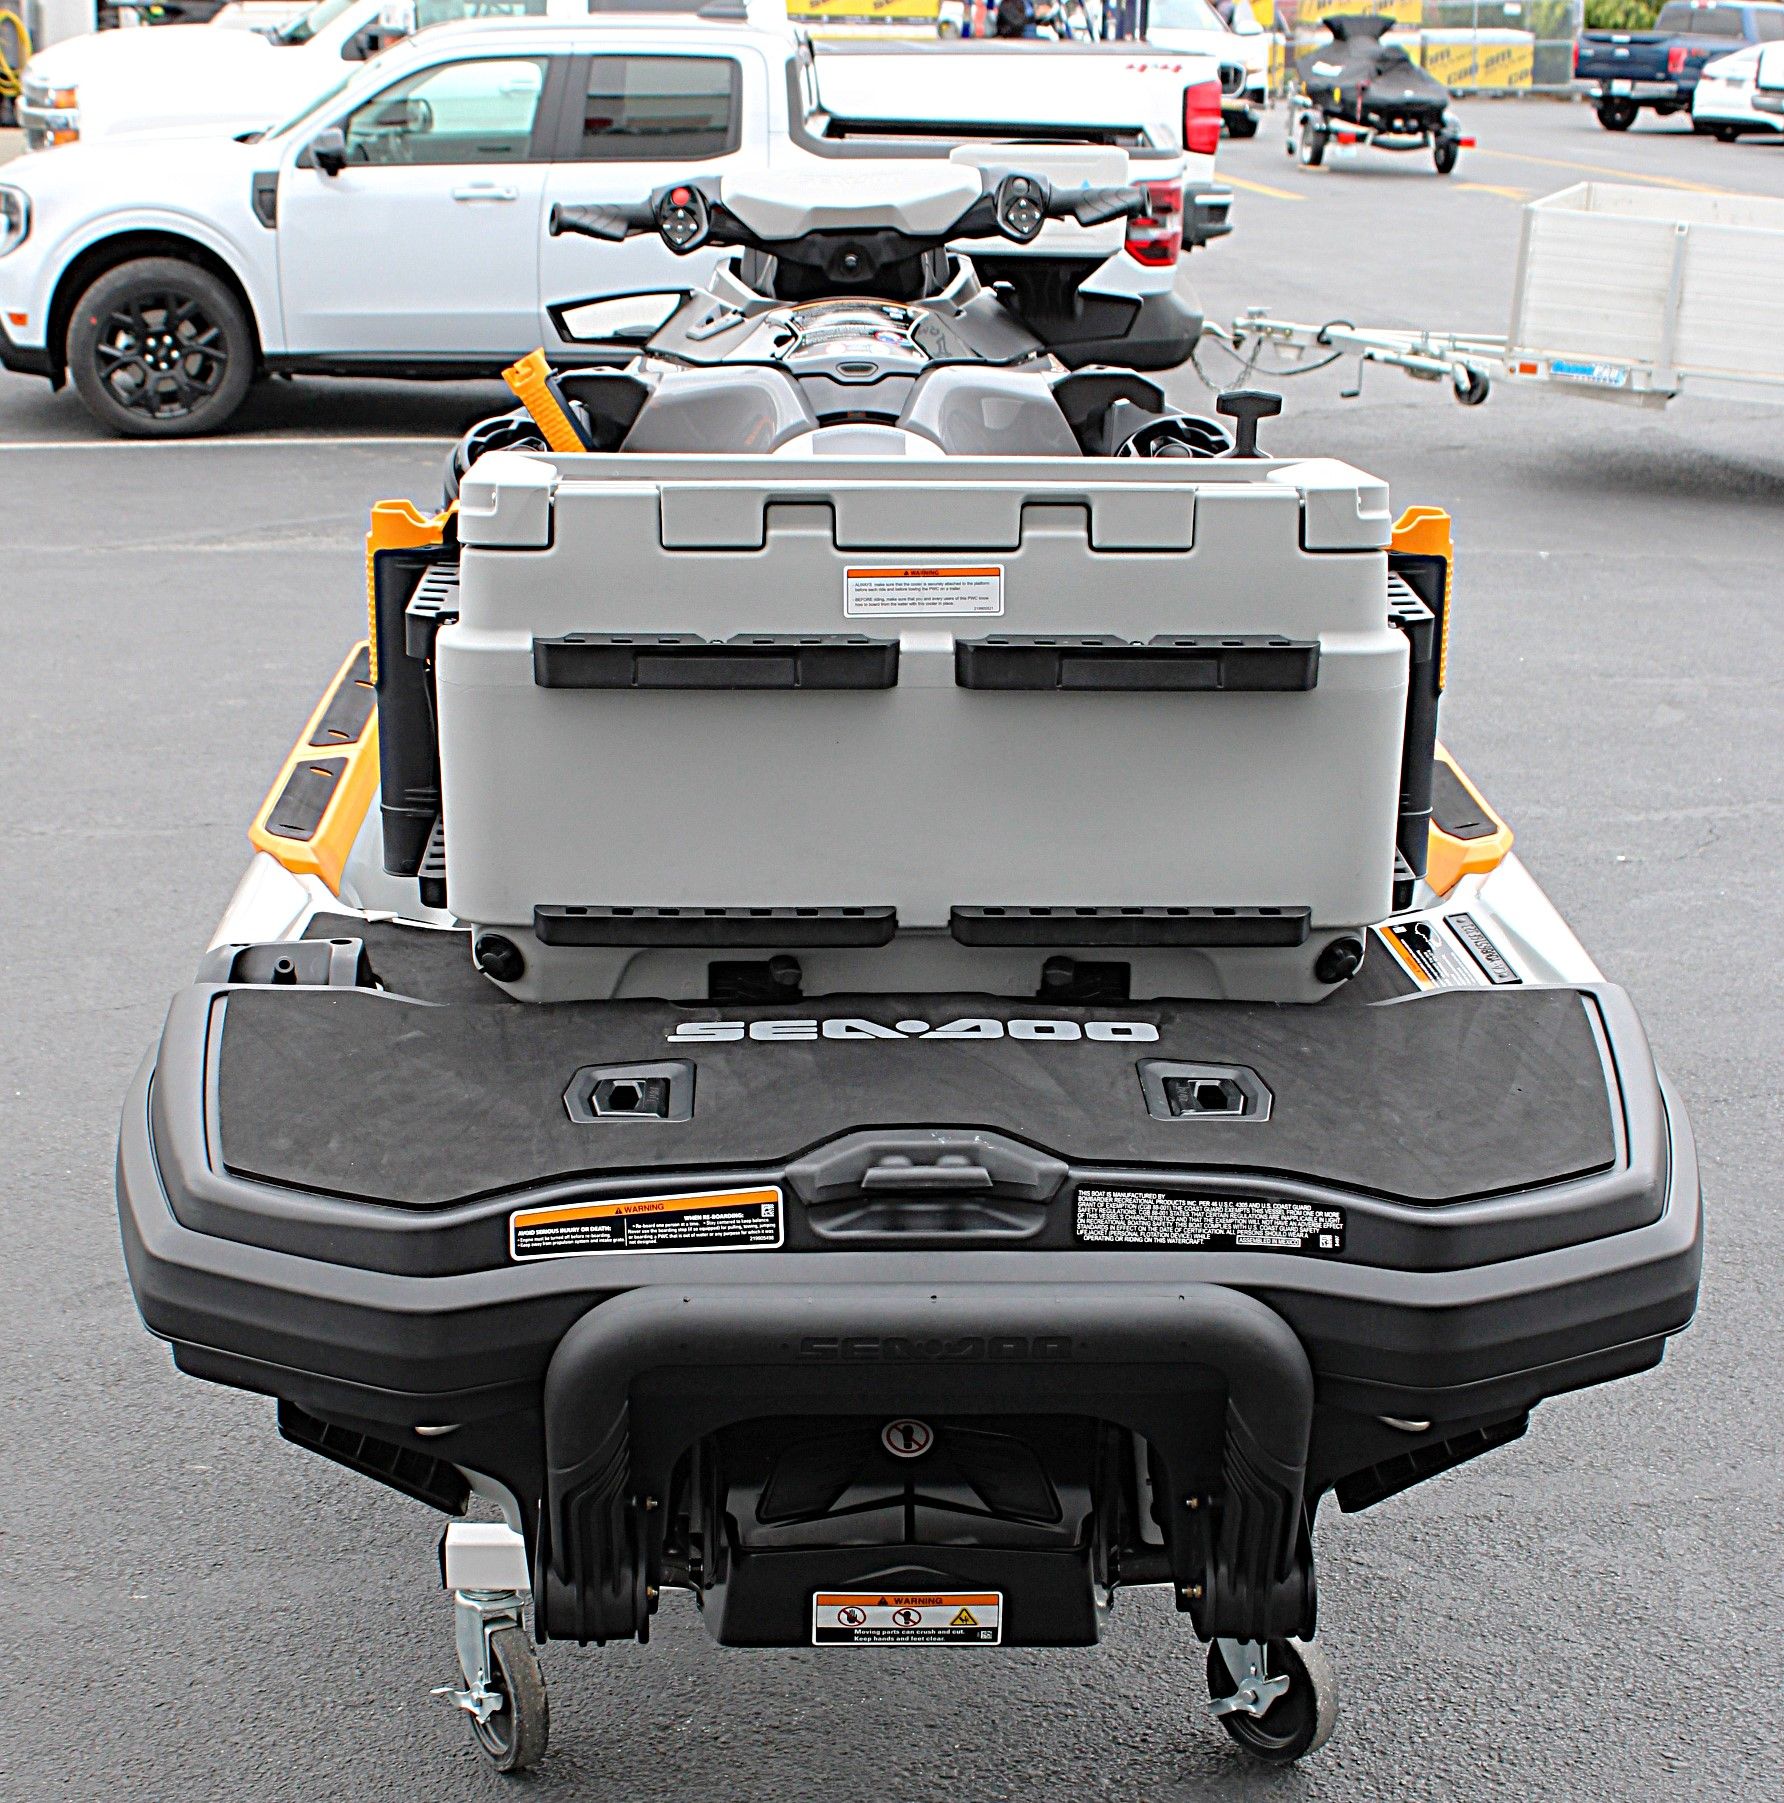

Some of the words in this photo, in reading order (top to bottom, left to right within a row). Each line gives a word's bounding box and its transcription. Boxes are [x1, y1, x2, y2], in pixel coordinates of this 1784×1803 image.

[624, 1203, 664, 1214] WARNING
[1125, 1214, 1175, 1222] CHARACTERISTICS
[893, 1597, 943, 1605] WARNING
